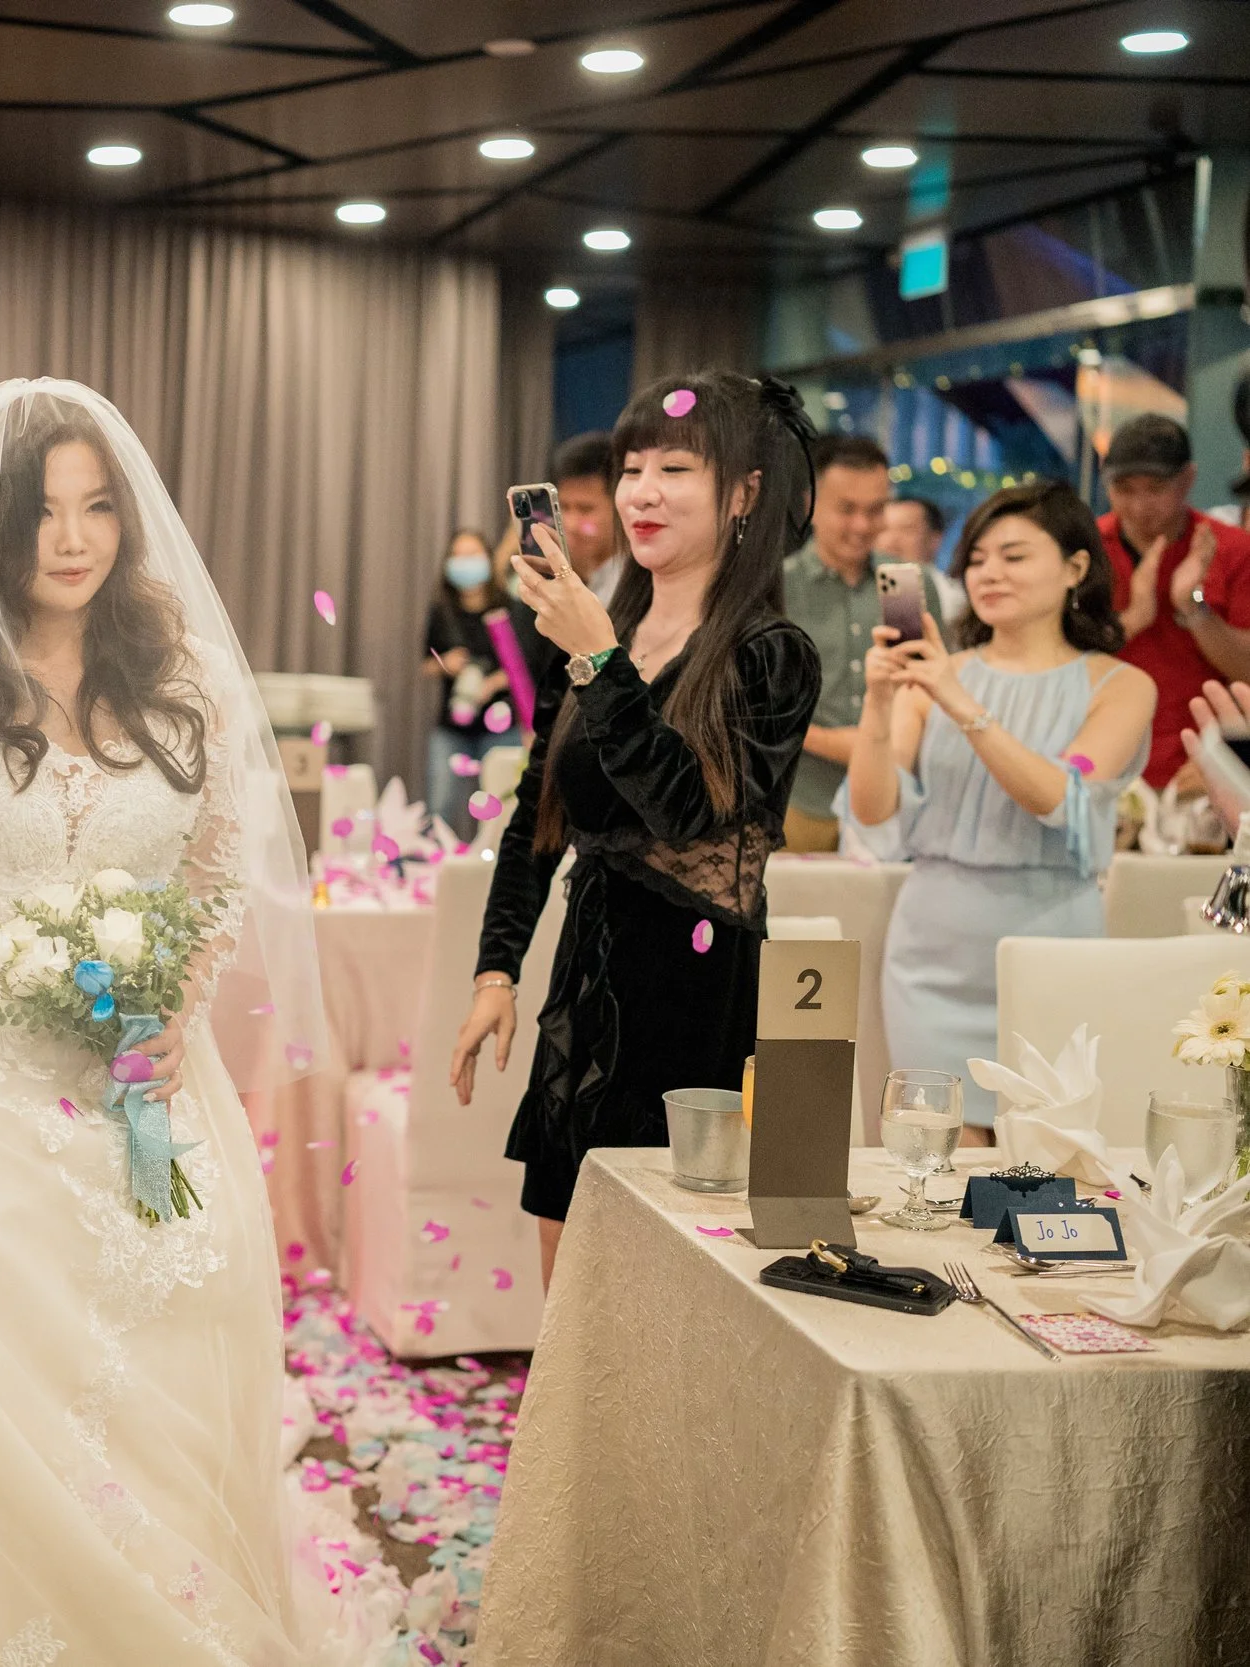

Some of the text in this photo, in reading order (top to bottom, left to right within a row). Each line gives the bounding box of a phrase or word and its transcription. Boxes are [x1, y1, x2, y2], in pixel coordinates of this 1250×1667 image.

[794, 968, 823, 1010] 2
[1036, 1219, 1078, 1241] Jo Jo
